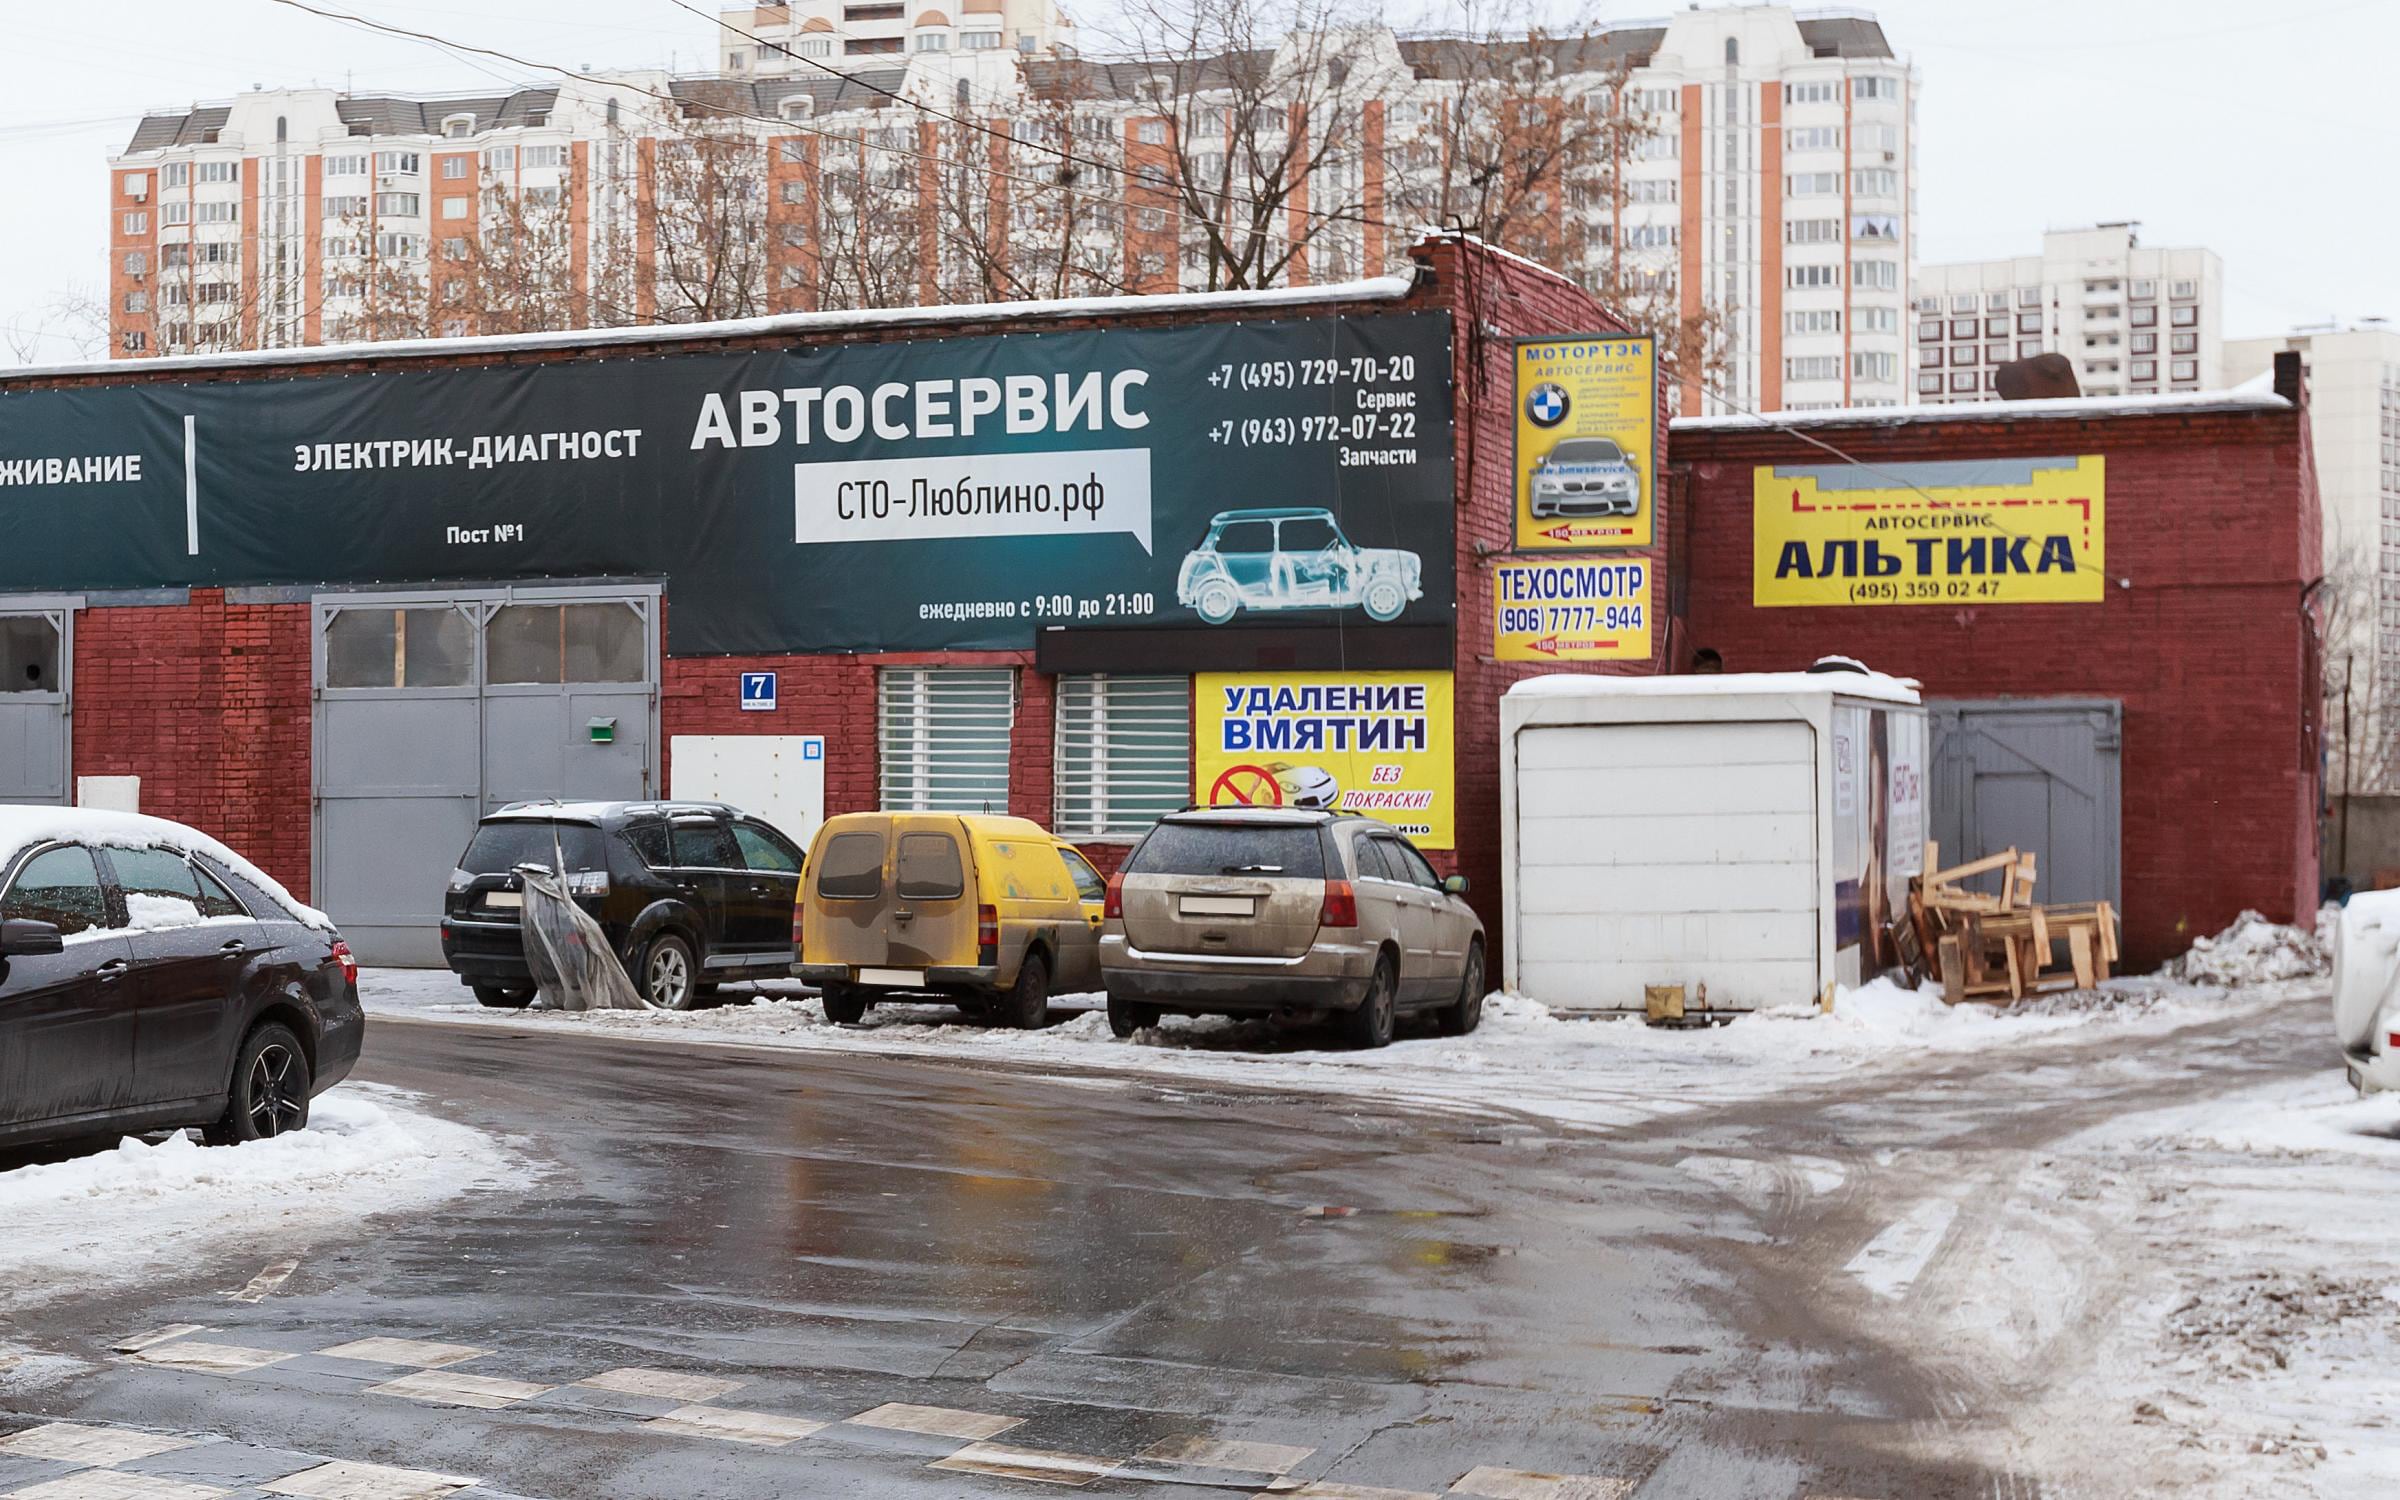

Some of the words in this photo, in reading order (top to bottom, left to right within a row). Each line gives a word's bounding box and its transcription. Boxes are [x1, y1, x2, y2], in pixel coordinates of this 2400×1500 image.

[1526, 344, 1642, 360] МОТОРТЭК
[1208, 365, 1233, 389] +7
[1240, 361, 1295, 391] (495)
[1301, 355, 1415, 385] 729-70-20
[1535, 363, 1634, 378] АВТОСЕРВИС
[690, 369, 1151, 449] АВТОСЕРВИС
[1356, 389, 1416, 412] Сервис
[1208, 421, 1234, 445] +7
[1241, 418, 1296, 447] (963)
[1302, 413, 1416, 441] 972-07-22
[294, 429, 642, 471] ЭЛЕКТРИК-ДИАГНОСТ
[1340, 447, 1416, 466] Запчасти
[837, 472, 1104, 521] СТО-Люблино.рф
[447, 527, 489, 544] Пост
[494, 524, 523, 543] №1
[1866, 515, 1993, 530] АВТОСЕРВИС
[1775, 536, 2076, 579] АЛЬТИКА
[1499, 566, 1642, 600] ТЕХОСМОТР
[1849, 582, 1898, 602] (495)
[1905, 582, 1940, 597] 359
[1947, 581, 1970, 597] 02
[1976, 581, 2000, 597] 47
[919, 602, 1016, 621] ежедневно
[1020, 602, 1031, 617] с
[1035, 595, 1073, 617] 9:00
[1077, 600, 1100, 619] до
[1105, 593, 1154, 615] 21:00
[1500, 606, 1545, 634] (906)
[1550, 606, 1642, 631] 7777-944
[751, 677, 766, 698] 7
[1225, 687, 1424, 716] УДАЛЕНИЕ
[1224, 719, 1425, 749] ВМЯТИН
[1372, 767, 1402, 783] БЕЗ
[1343, 791, 1432, 808] ПОКРАСКИ!
